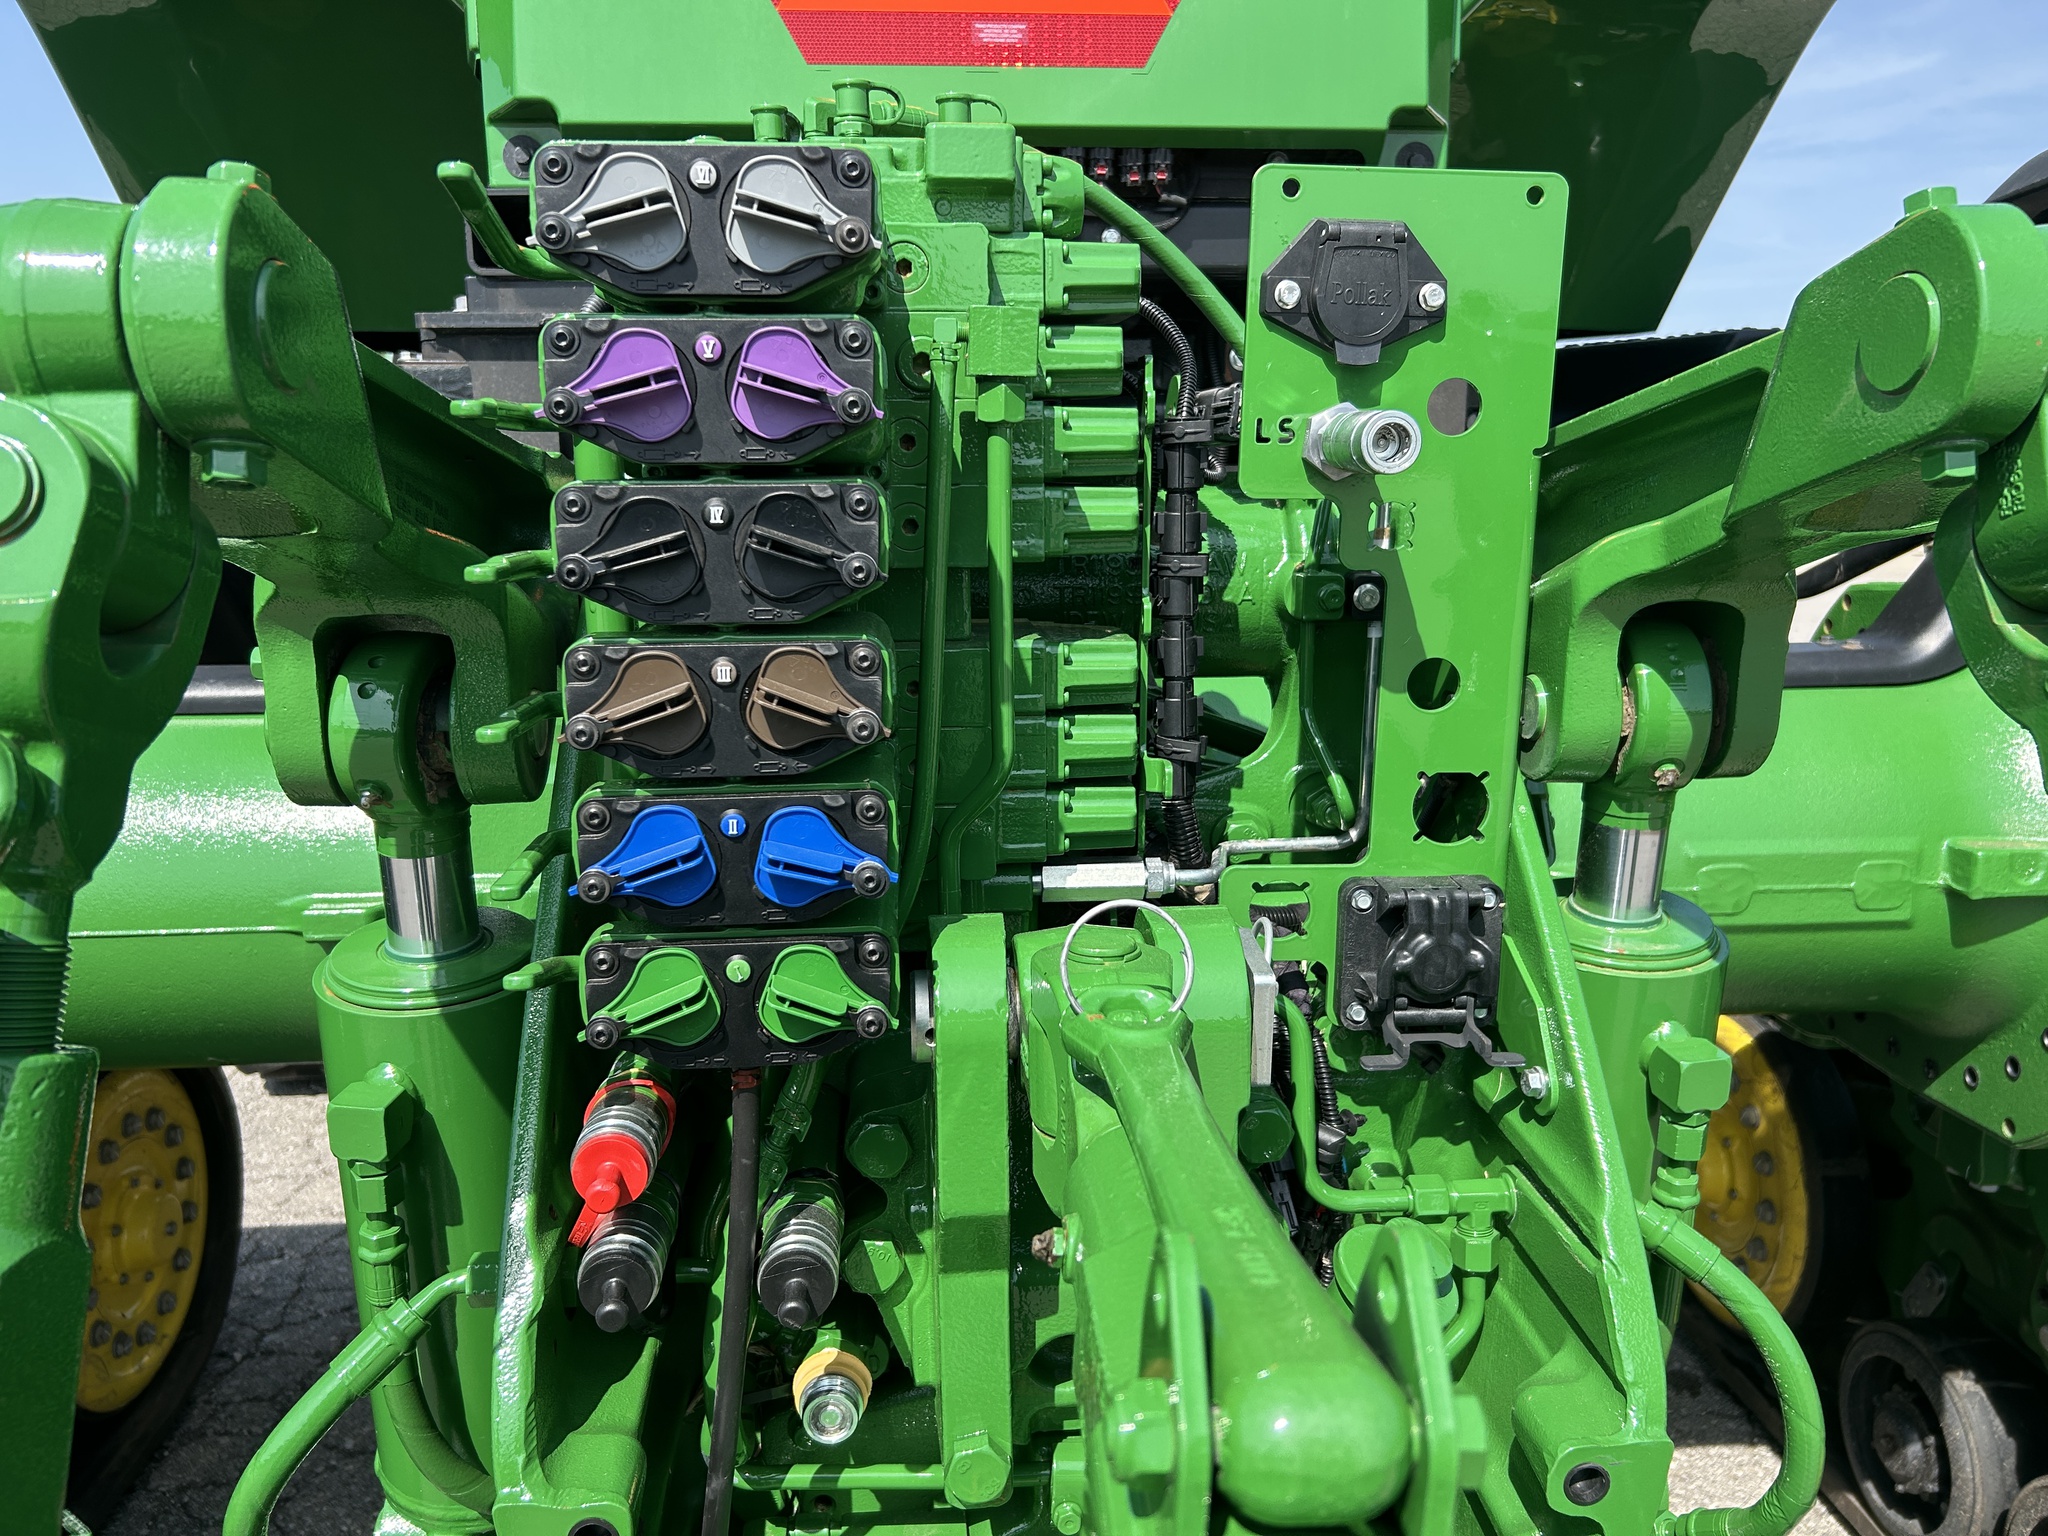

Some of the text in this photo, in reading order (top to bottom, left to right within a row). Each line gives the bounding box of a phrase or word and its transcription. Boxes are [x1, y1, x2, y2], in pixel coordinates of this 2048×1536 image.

[695, 165, 711, 184] VI
[1330, 281, 1393, 307] Pollak
[701, 339, 716, 359] V
[1255, 417, 1296, 444] LS
[709, 506, 724, 524] IV
[716, 666, 732, 683] III
[728, 819, 739, 835] II
